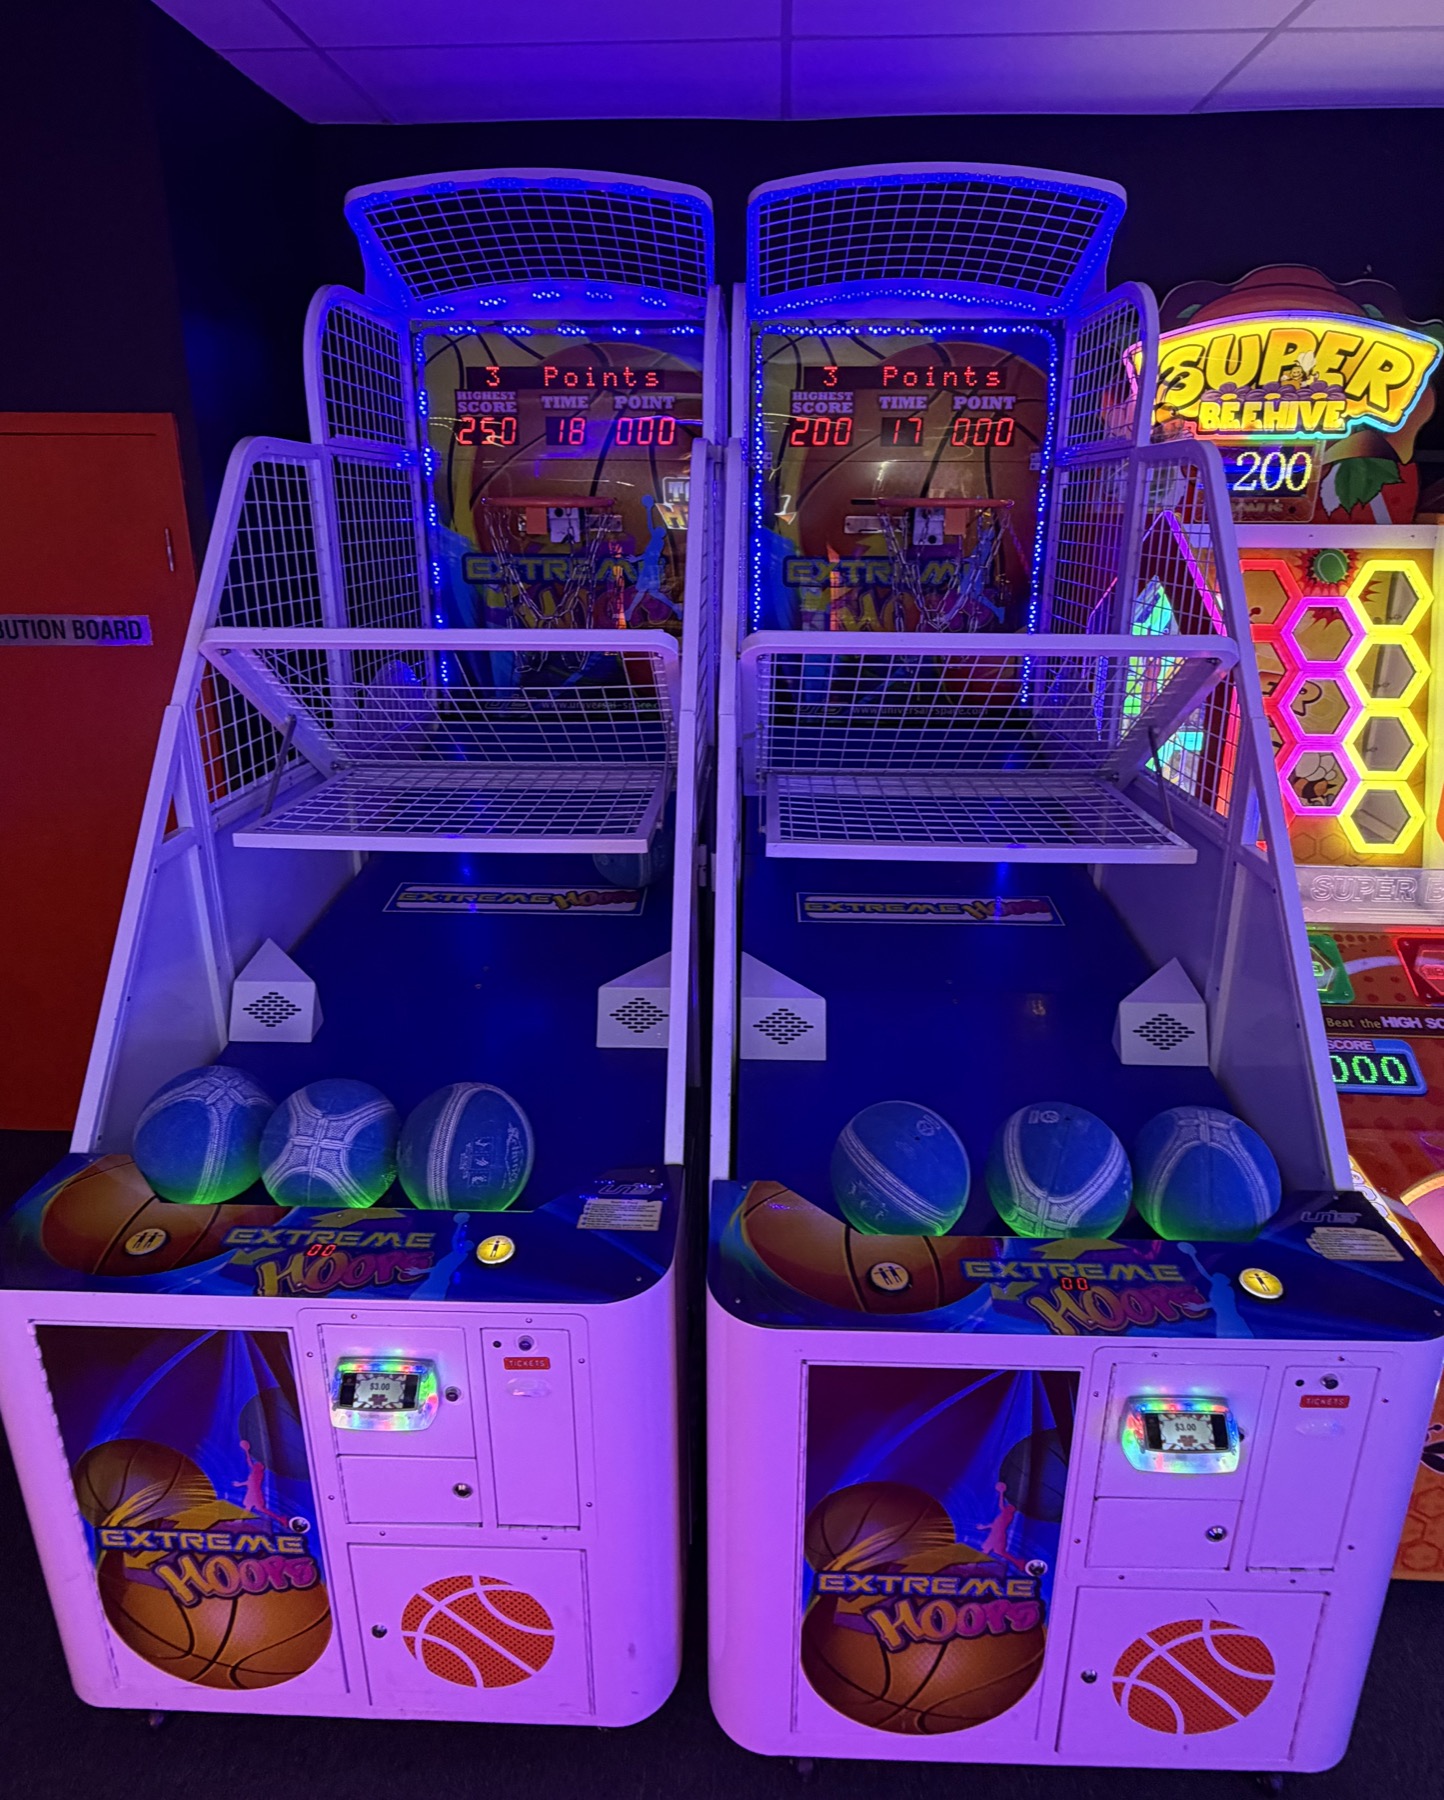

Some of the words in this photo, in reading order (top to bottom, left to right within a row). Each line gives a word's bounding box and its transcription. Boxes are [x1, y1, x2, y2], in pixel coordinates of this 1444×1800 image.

[485, 366, 501, 387] 3
[543, 366, 660, 387] Points
[823, 366, 838, 387] 3
[882, 366, 1001, 387] Points
[1158, 327, 1416, 413] SUPER
[457, 391, 516, 401] HIGHEST
[541, 395, 589, 410] TIME
[614, 395, 675, 410] POINT
[792, 391, 854, 401] HIGHEST
[879, 396, 927, 410] TIME
[953, 396, 1016, 410] POINT
[457, 401, 518, 414] SCORE
[791, 401, 854, 414] SCORE
[1198, 400, 1347, 432] BEEHIVE
[458, 416, 518, 446] 250
[559, 417, 586, 446] 18
[615, 416, 677, 446] 000
[790, 417, 853, 446] 200
[892, 417, 923, 446] 17
[951, 417, 1015, 446] 000
[1232, 451, 1313, 492] 200
[786, 559, 988, 584] EXTRM
[0, 619, 66, 640] UTION
[72, 619, 143, 640] BOARD
[398, 891, 552, 904] EXTREME
[1310, 874, 1418, 903] SUPER
[804, 901, 962, 914] EXTREME
[1325, 1017, 1355, 1028] Beat
[1360, 1018, 1381, 1029] the
[1380, 1016, 1423, 1029] HIGH
[1327, 1040, 1375, 1051] SCORE
[224, 1227, 437, 1248] EXTREME
[306, 1243, 337, 1257] 00
[962, 1260, 1185, 1281] EXTREME
[1060, 1277, 1088, 1291] 00
[508, 1359, 546, 1367] TICKETS
[369, 1382, 391, 1391] $3.00
[1174, 1422, 1197, 1432] $3.00
[99, 1529, 306, 1555] EXTREME
[155, 1553, 317, 1606] HOOPS
[817, 1573, 1038, 1598] EXTREME
[866, 1598, 1041, 1651] HOOPS
